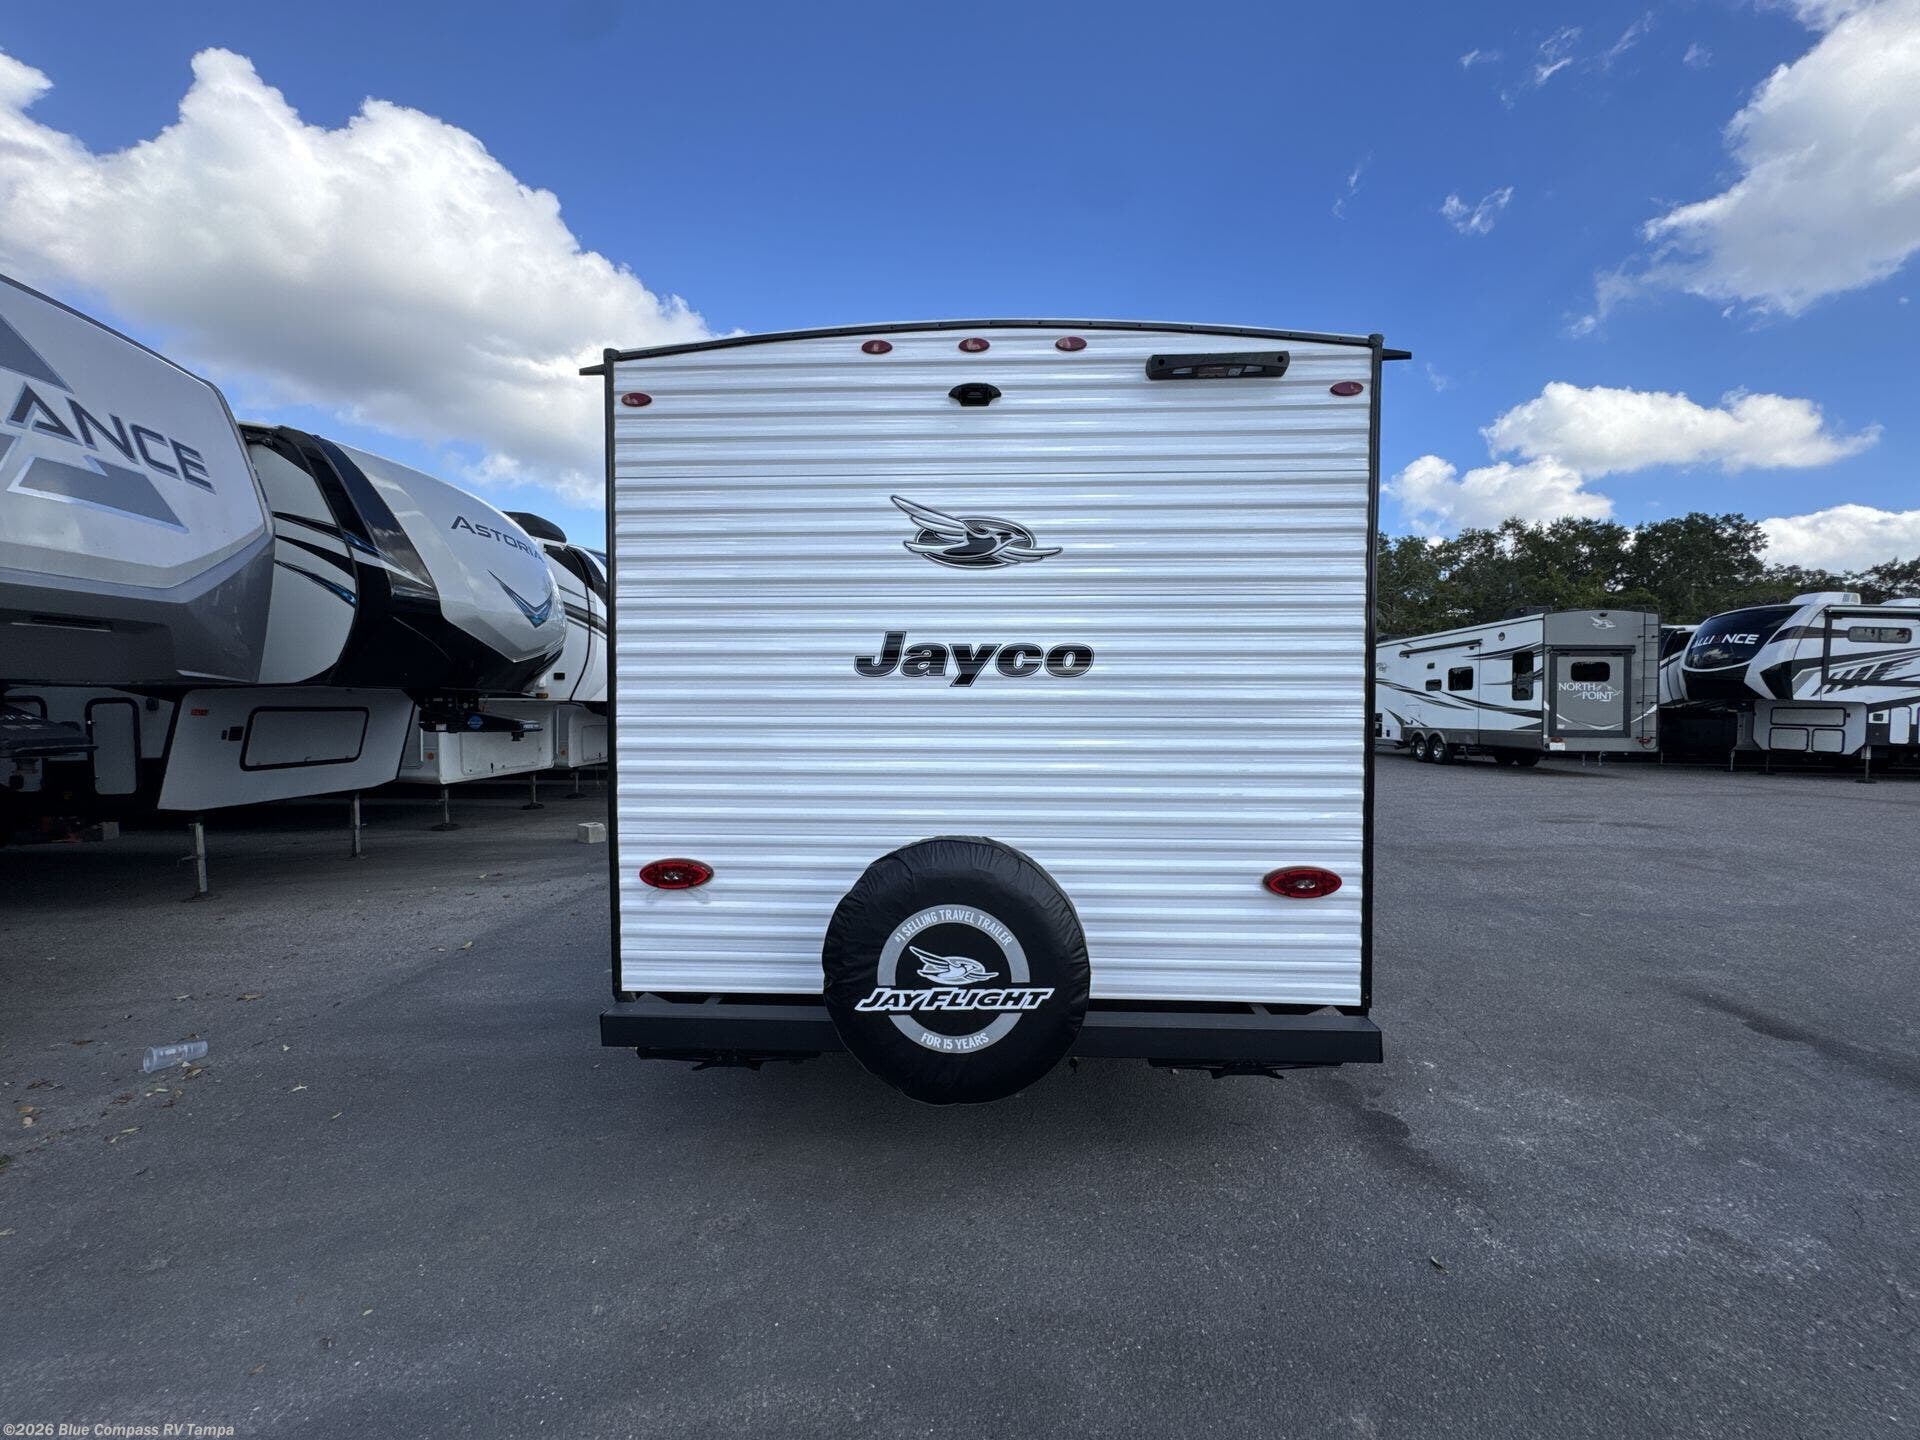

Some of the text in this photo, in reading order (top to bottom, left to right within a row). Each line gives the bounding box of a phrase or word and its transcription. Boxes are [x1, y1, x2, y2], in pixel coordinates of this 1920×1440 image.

[450, 515, 545, 564] ASTORIA
[853, 630, 1096, 688] Jayco
[1558, 682, 1596, 692] NORTH
[1582, 691, 1614, 701] POINT
[902, 911, 938, 937] SELLING
[938, 909, 975, 924] TRAVEL
[977, 914, 1013, 946] TRAILER
[920, 1032, 989, 1050] FOR 15 YEARS
